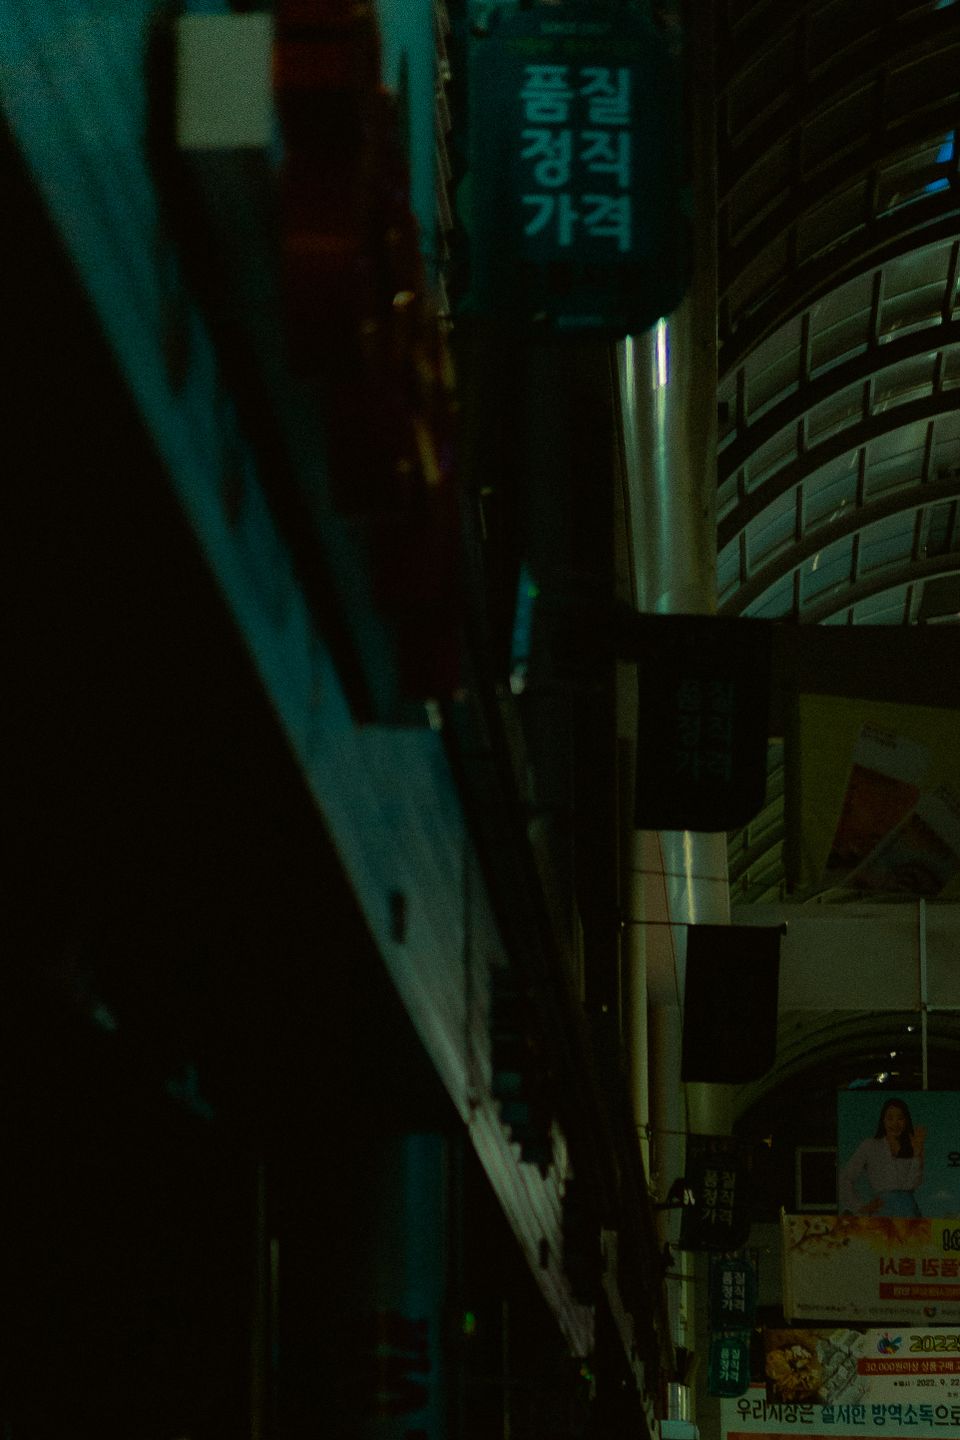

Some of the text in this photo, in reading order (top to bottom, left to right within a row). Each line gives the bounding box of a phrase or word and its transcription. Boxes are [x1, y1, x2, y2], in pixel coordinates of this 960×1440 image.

[519, 63, 633, 126] 품질
[519, 127, 633, 189] 정직
[520, 193, 634, 253] 가격
[703, 1169, 737, 1189] 품질
[702, 1189, 736, 1208] 정직
[701, 1208, 734, 1227] 가격
[721, 1271, 746, 1285] 품질
[721, 1285, 746, 1298] 정직
[721, 1299, 746, 1313] 가격
[719, 1347, 741, 1359] 품질
[719, 1359, 741, 1371] 정직
[718, 1370, 740, 1383] 가격
[736, 1398, 815, 1424] 우리시장은
